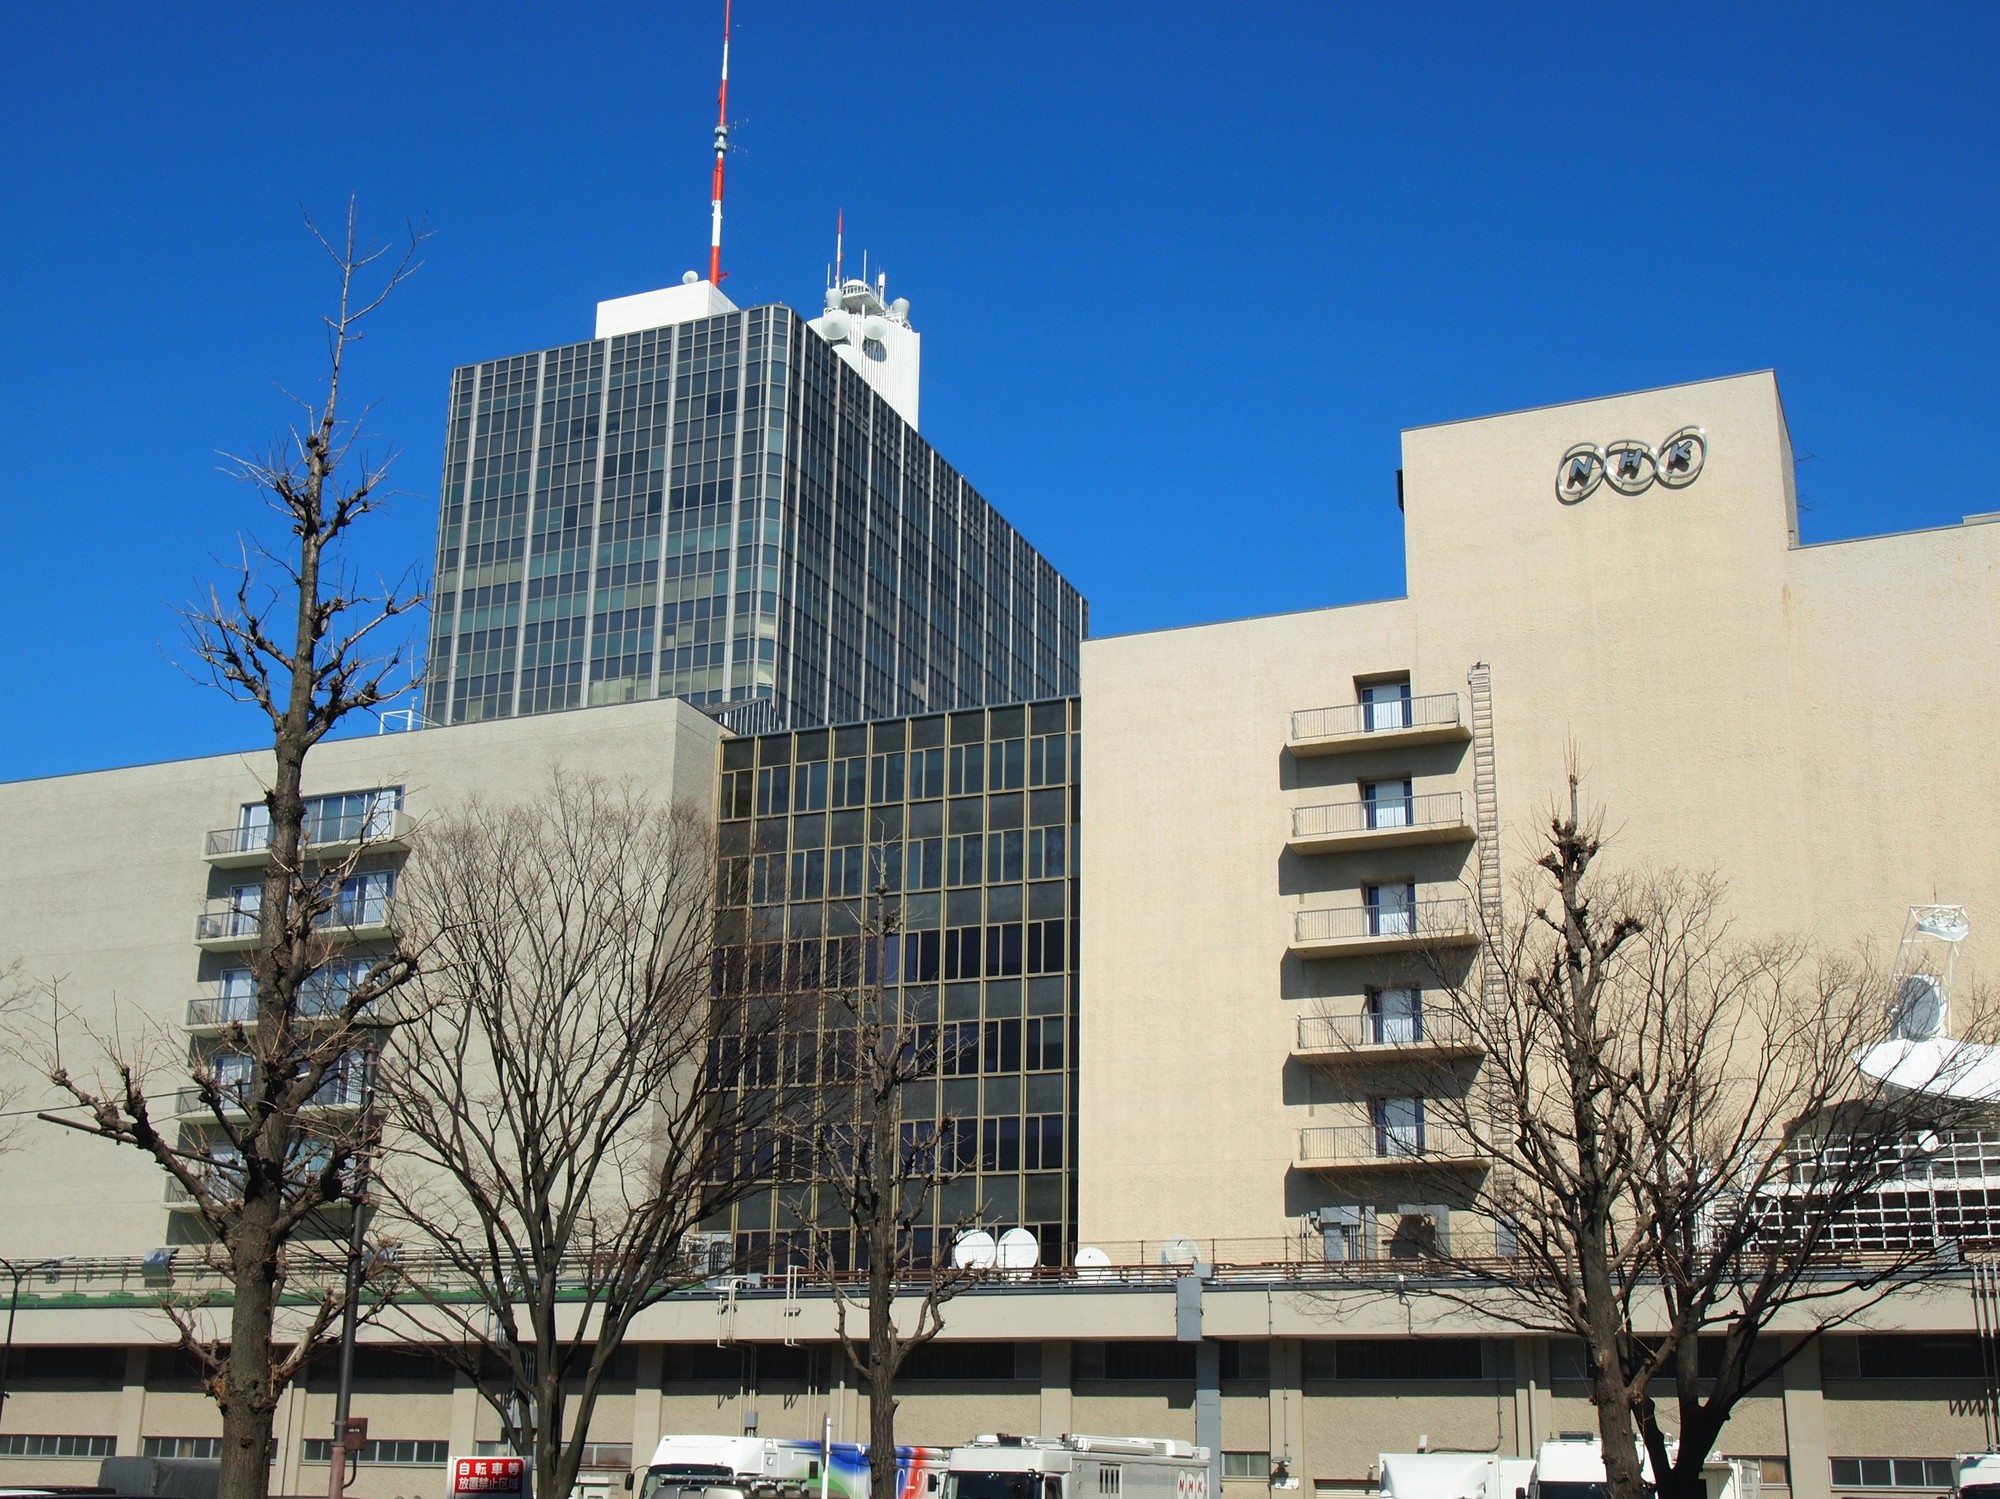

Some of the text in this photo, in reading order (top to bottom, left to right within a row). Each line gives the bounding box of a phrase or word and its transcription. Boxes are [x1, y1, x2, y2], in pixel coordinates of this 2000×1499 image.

[1566, 439, 1694, 481] NHK
[459, 1462, 520, 1475] 自転車等
[458, 1477, 519, 1490] 放置禁止区域
[1178, 1479, 1203, 1493] NHK
